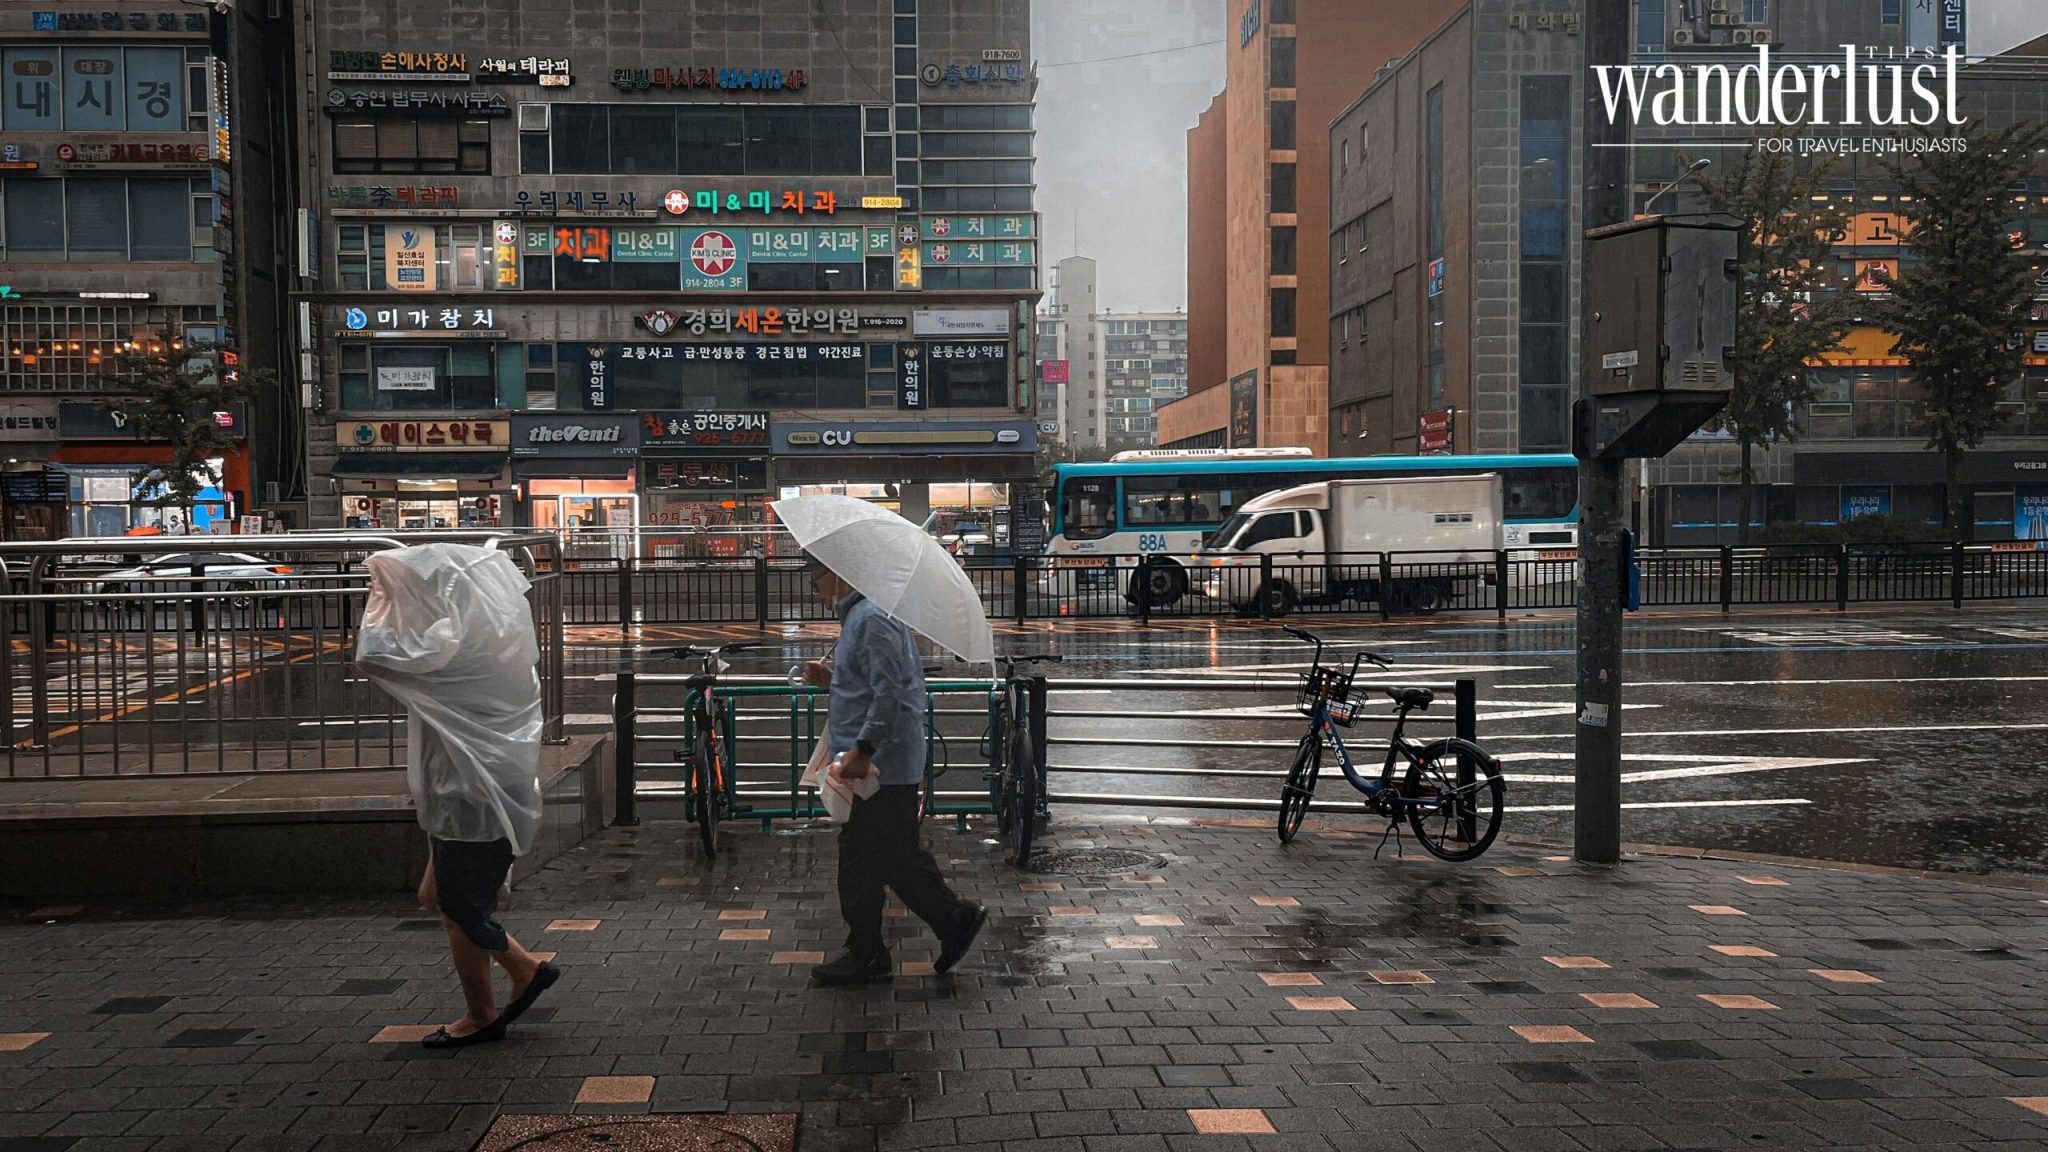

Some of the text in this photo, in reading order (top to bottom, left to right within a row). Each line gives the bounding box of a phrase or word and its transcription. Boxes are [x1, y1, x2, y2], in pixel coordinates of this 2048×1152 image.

[381, 52, 467, 72] 손해사정사
[984, 50, 1020, 60] 918-7600
[80, 61, 107, 74] 대장
[479, 56, 570, 76] 사월의 테라피
[614, 68, 650, 90] 웰빙
[654, 67, 716, 90] 마사지
[786, 69, 804, 90] 4F
[16, 80, 171, 119] 내시경
[350, 90, 508, 109] 송연 법무사 사무소
[515, 191, 638, 212] 우리세무사
[781, 190, 837, 215] 치과
[864, 199, 900, 207] 914-2804
[968, 217, 1023, 235] 치과
[527, 232, 547, 246] 3F
[555, 227, 610, 261] 치과
[617, 231, 674, 250] 미&미
[752, 231, 809, 251] 미&미
[818, 231, 859, 252] 치과
[870, 233, 889, 249] 3F
[712, 249, 735, 257] CLINIC
[968, 243, 1023, 261] 치과
[498, 246, 518, 287] 치과
[899, 247, 918, 288] 치과
[685, 277, 743, 288] 914-2804 3F
[377, 308, 494, 330] 미가참치
[621, 347, 674, 360] 교통사고
[818, 347, 862, 359] 야간진료
[590, 360, 606, 407] 한의원
[904, 360, 920, 407] 한의원
[380, 422, 493, 446] 에이스약국
[668, 419, 692, 436] 좋은
[694, 413, 767, 431] 공인중개사
[1043, 423, 1057, 432] CU
[822, 430, 852, 446] CU
[658, 463, 730, 487] 부동산
[1139, 534, 1168, 552] 88A
